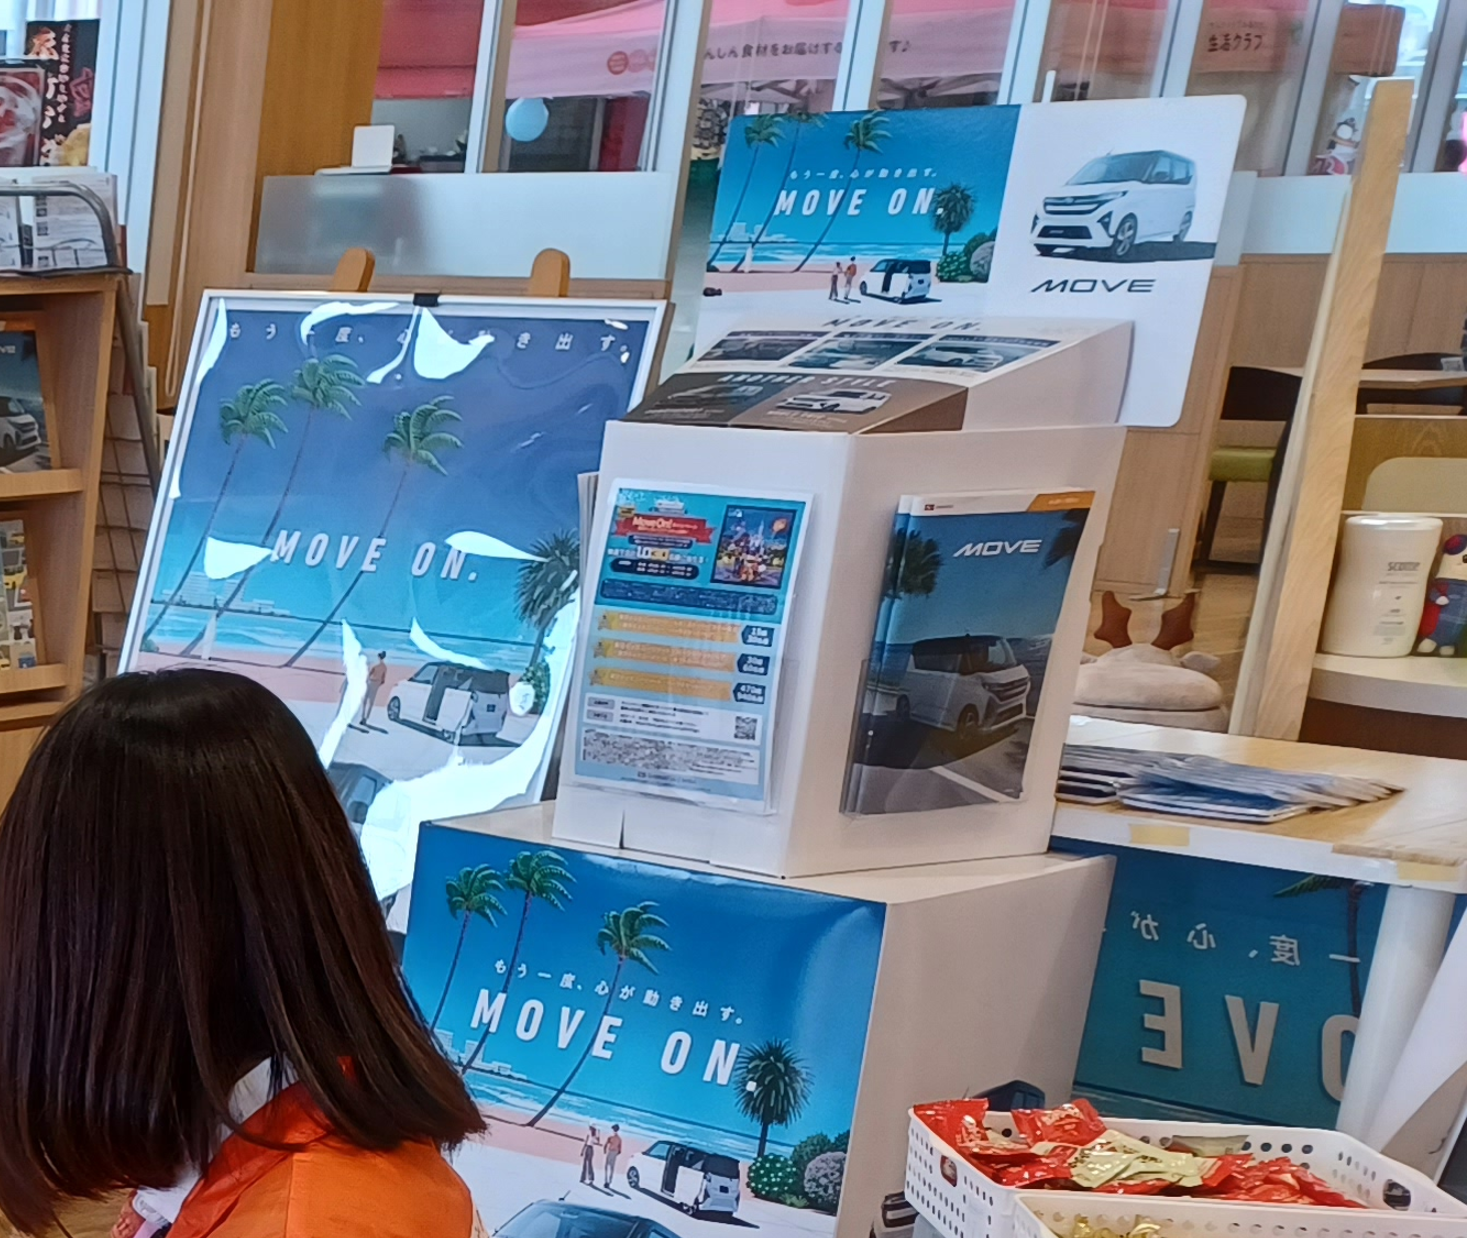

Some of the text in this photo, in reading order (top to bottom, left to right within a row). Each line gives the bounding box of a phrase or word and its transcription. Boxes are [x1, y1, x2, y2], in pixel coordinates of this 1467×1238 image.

[774, 186, 947, 218] MOVE ON.
[1030, 277, 1157, 294] MOVE
[271, 529, 480, 584] MOVE ON.
[953, 539, 1042, 558] MOVE
[493, 957, 746, 1026] もう一度、心が動き出す。
[470, 988, 757, 1095] MOVE ON.
